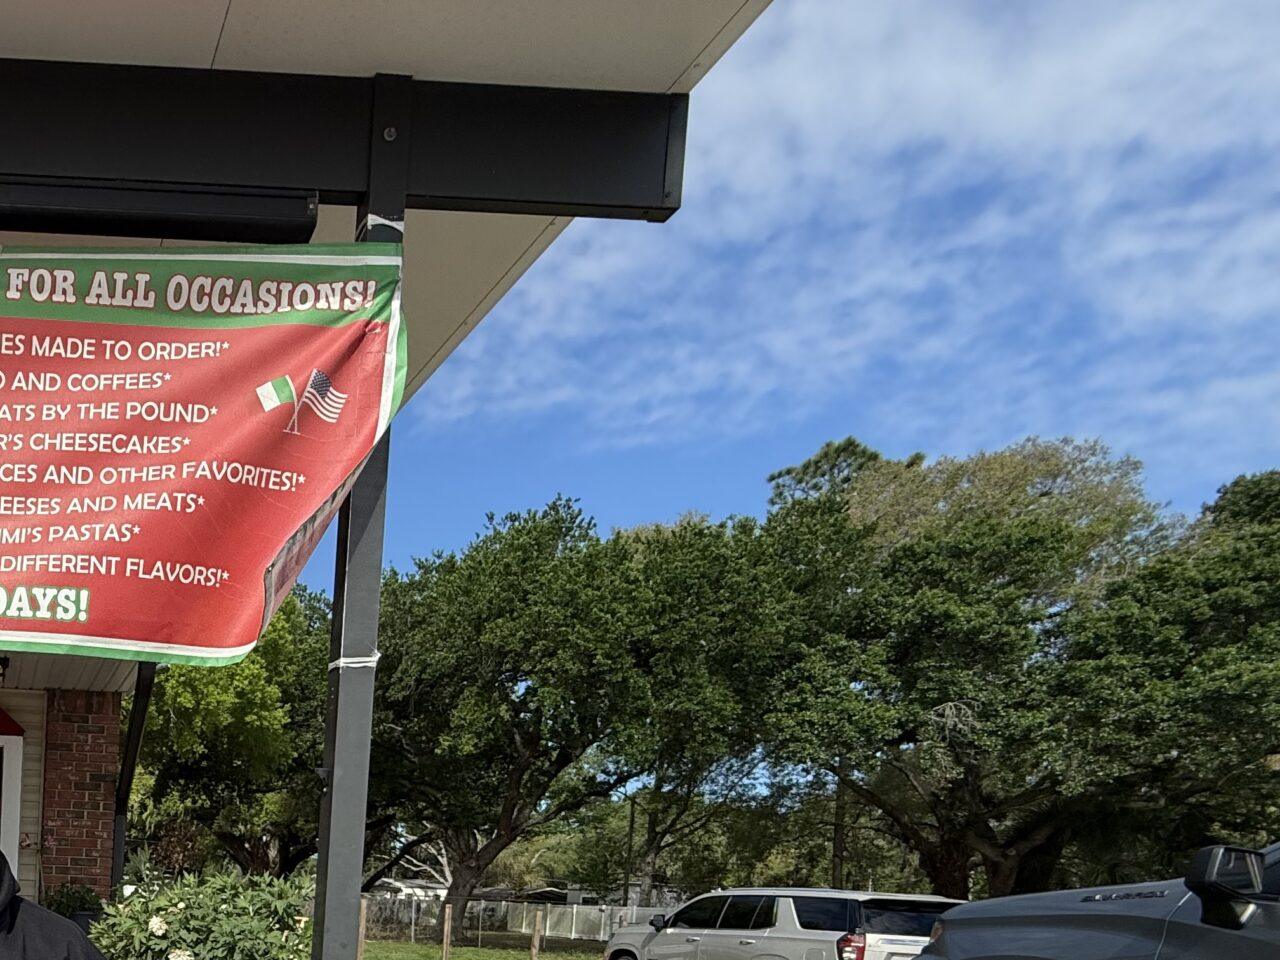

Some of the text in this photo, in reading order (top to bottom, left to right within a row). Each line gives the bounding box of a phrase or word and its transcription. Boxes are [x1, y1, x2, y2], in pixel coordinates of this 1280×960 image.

[7, 267, 76, 302] FOR
[86, 271, 155, 309] ALL
[167, 274, 376, 313] OCCASIONS!
[31, 335, 95, 359] MADE
[103, 340, 131, 360] TO
[12, 371, 61, 391] AND
[41, 404, 71, 420] BY
[77, 402, 118, 420] THE
[43, 465, 93, 485] AND
[99, 465, 176, 485] OTHER
[66, 495, 116, 513] AND
[0, 555, 120, 575] DIFFERENT
